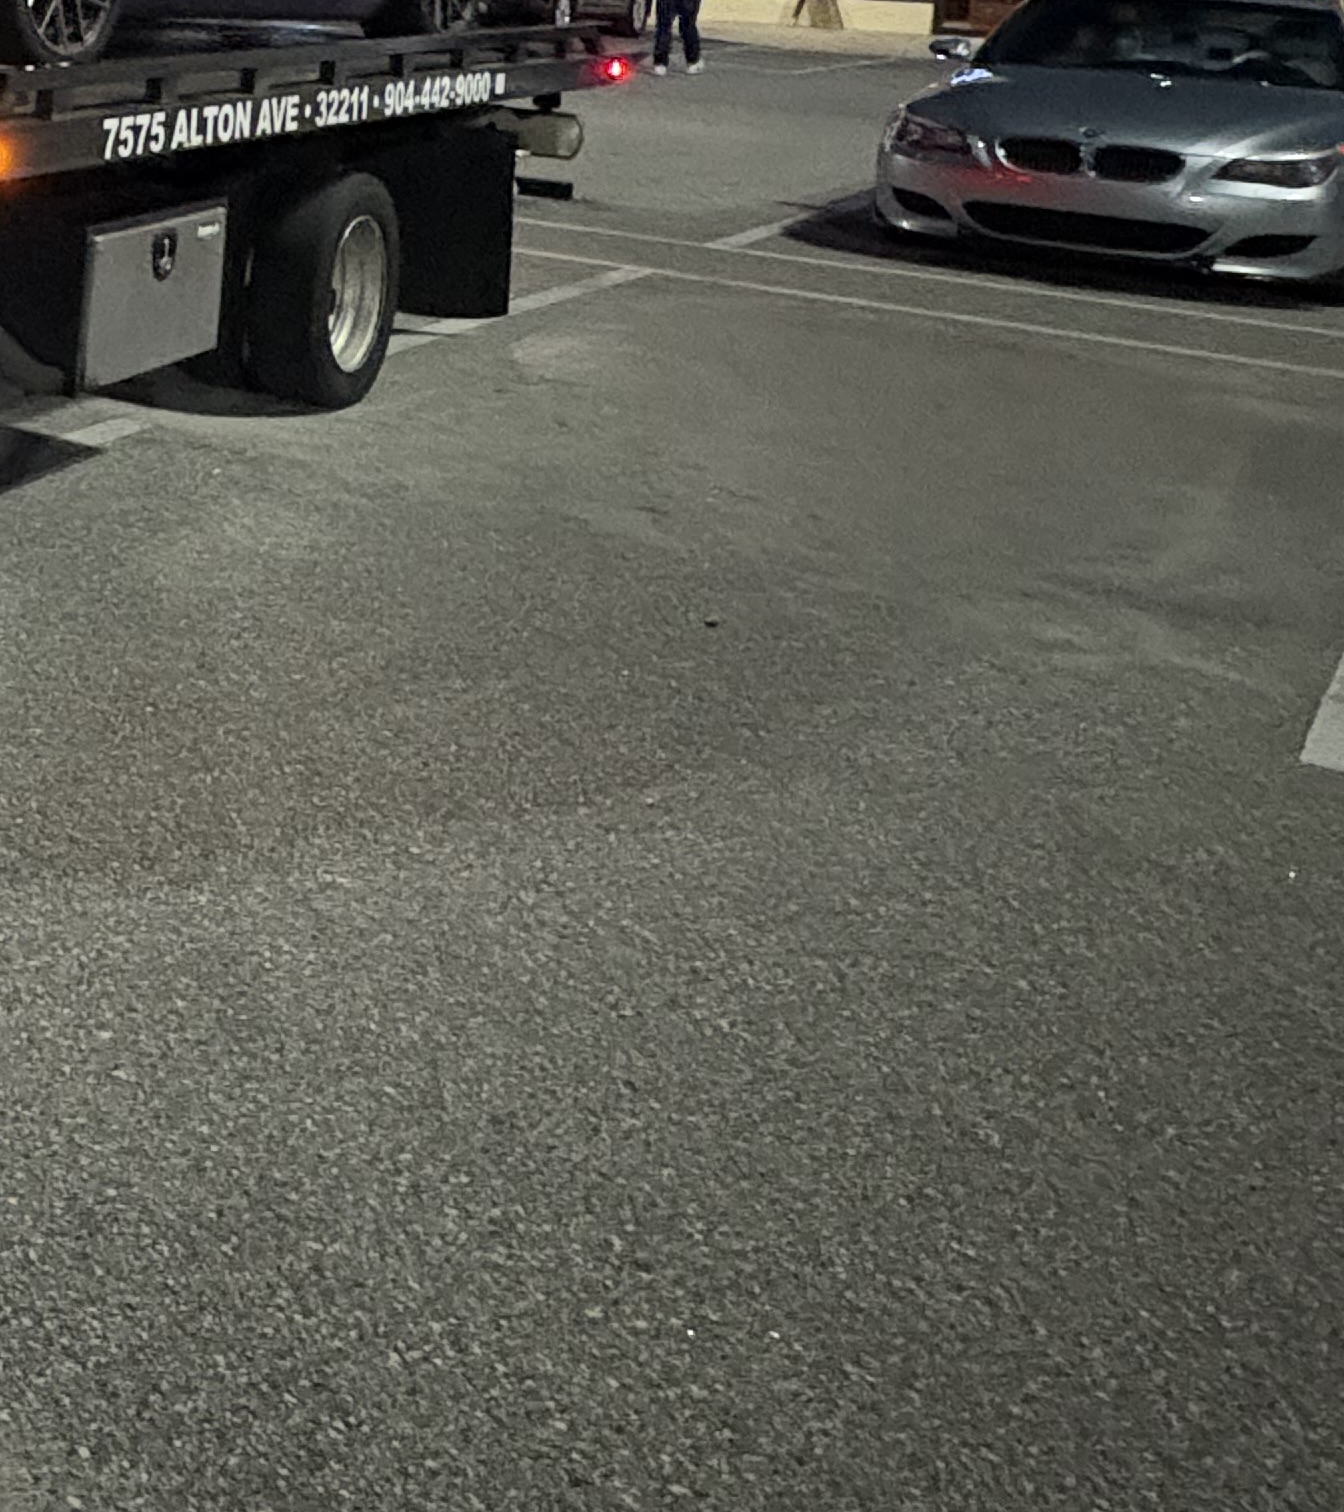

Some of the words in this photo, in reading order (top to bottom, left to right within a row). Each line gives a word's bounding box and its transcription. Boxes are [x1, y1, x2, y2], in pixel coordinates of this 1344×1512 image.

[102, 110, 165, 161] 7575
[170, 101, 252, 150] ALTON
[255, 95, 300, 138] AVE
[314, 85, 370, 128] 32211
[383, 72, 491, 116] 904-442-9000
